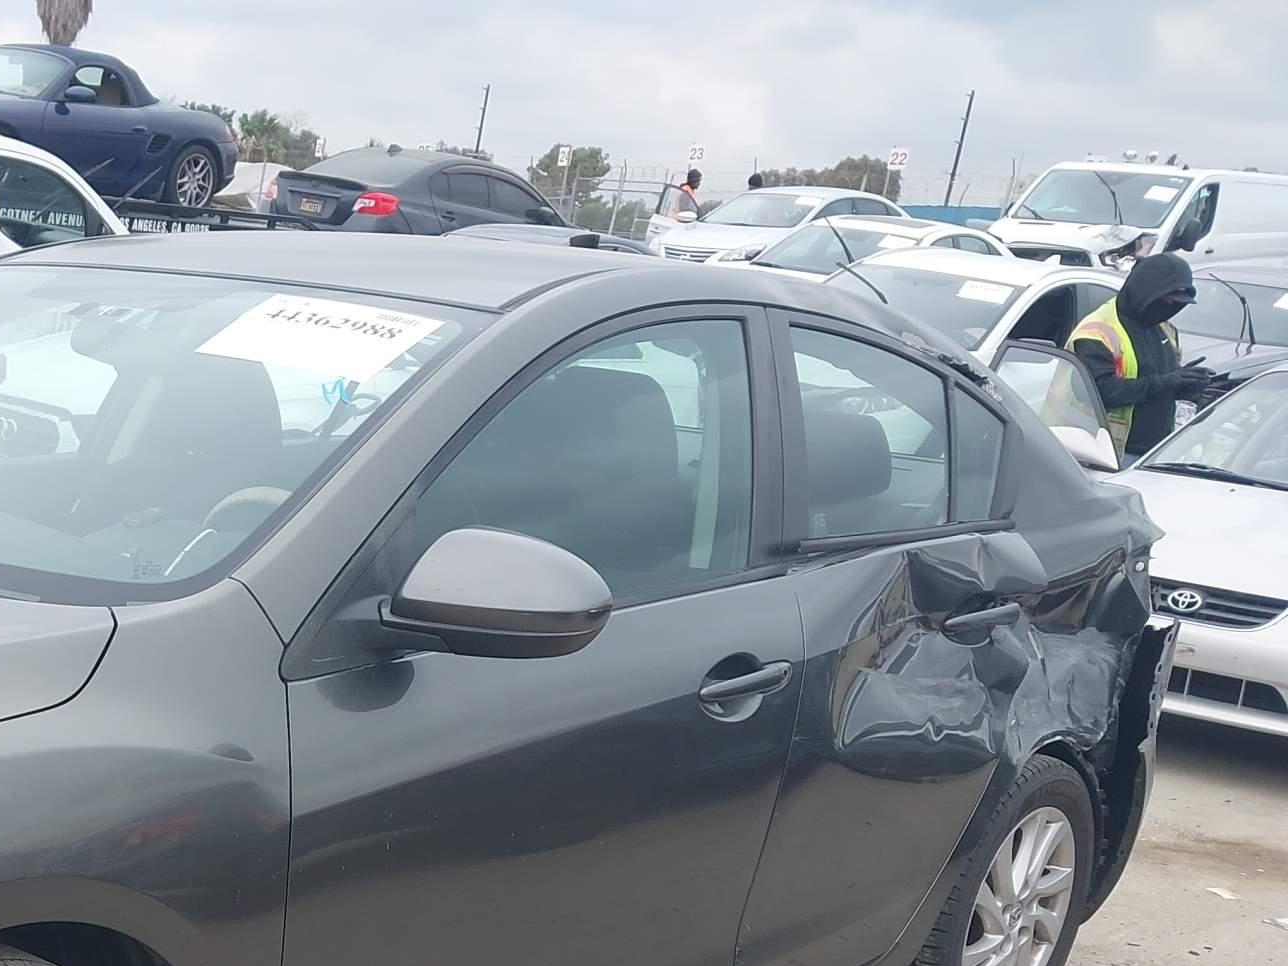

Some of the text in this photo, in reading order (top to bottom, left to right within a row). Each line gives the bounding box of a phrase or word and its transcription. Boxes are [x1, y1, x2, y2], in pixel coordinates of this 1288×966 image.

[689, 148, 704, 160] 23
[889, 152, 908, 165] 22
[47, 211, 86, 227] AVENU
[172, 222, 182, 233] CA
[266, 309, 402, 339] 44362988
